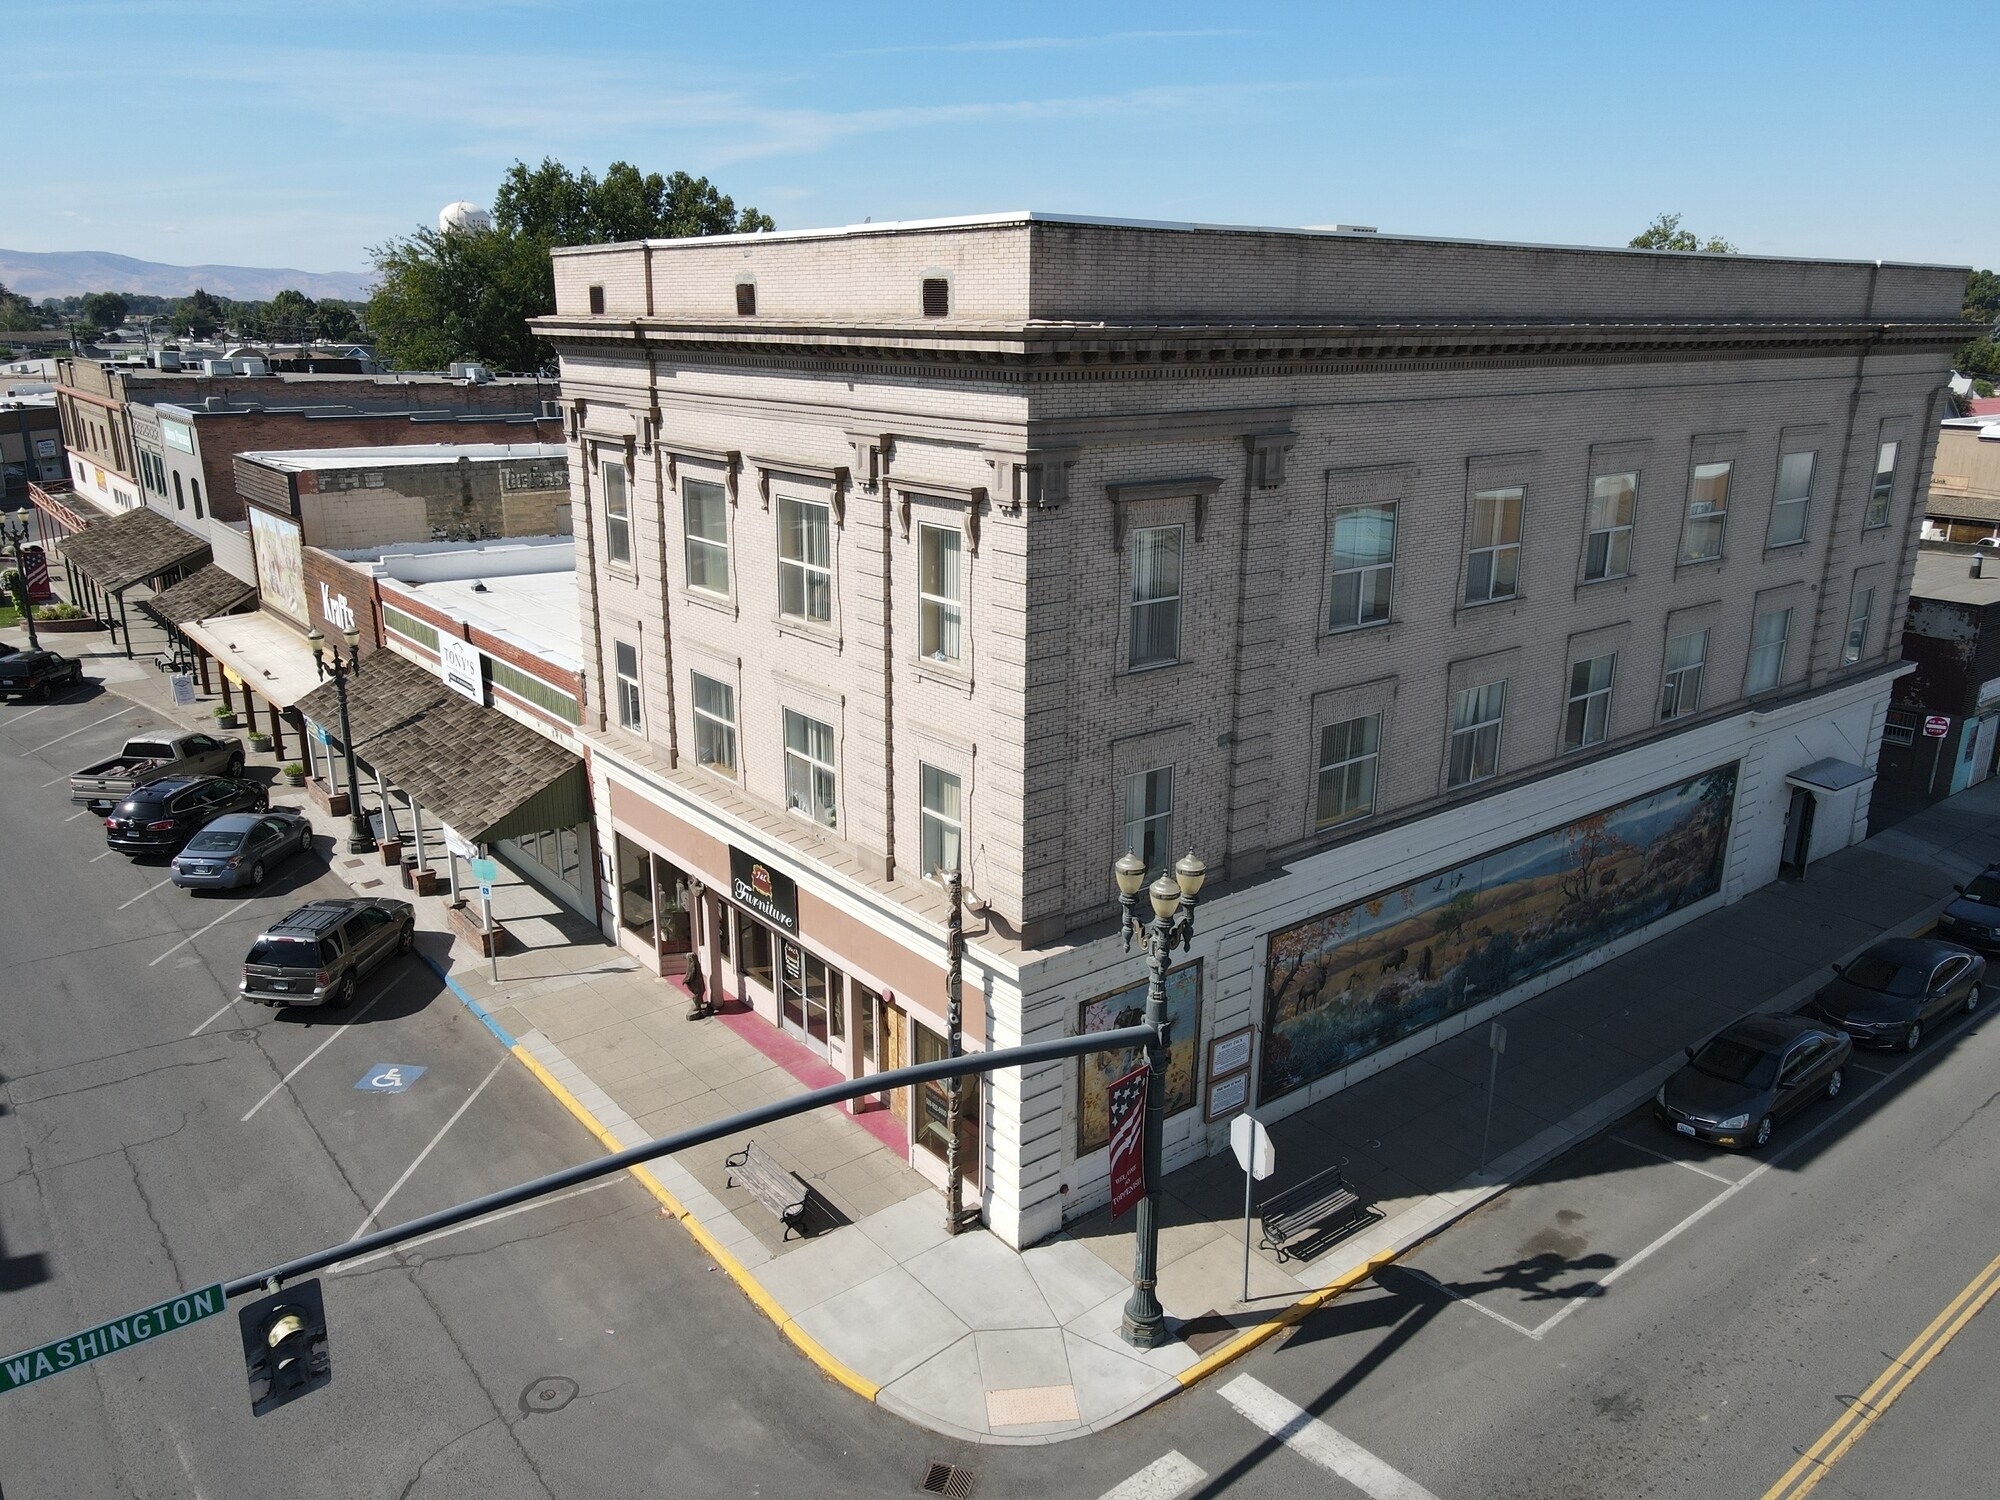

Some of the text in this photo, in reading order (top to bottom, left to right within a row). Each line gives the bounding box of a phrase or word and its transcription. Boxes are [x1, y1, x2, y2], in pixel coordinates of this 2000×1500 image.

[443, 647, 475, 675] TONY'S
[734, 877, 793, 928] Furniture
[1112, 1176, 1142, 1206] TOPPENISH
[5, 1290, 214, 1385] WASHINGTON
